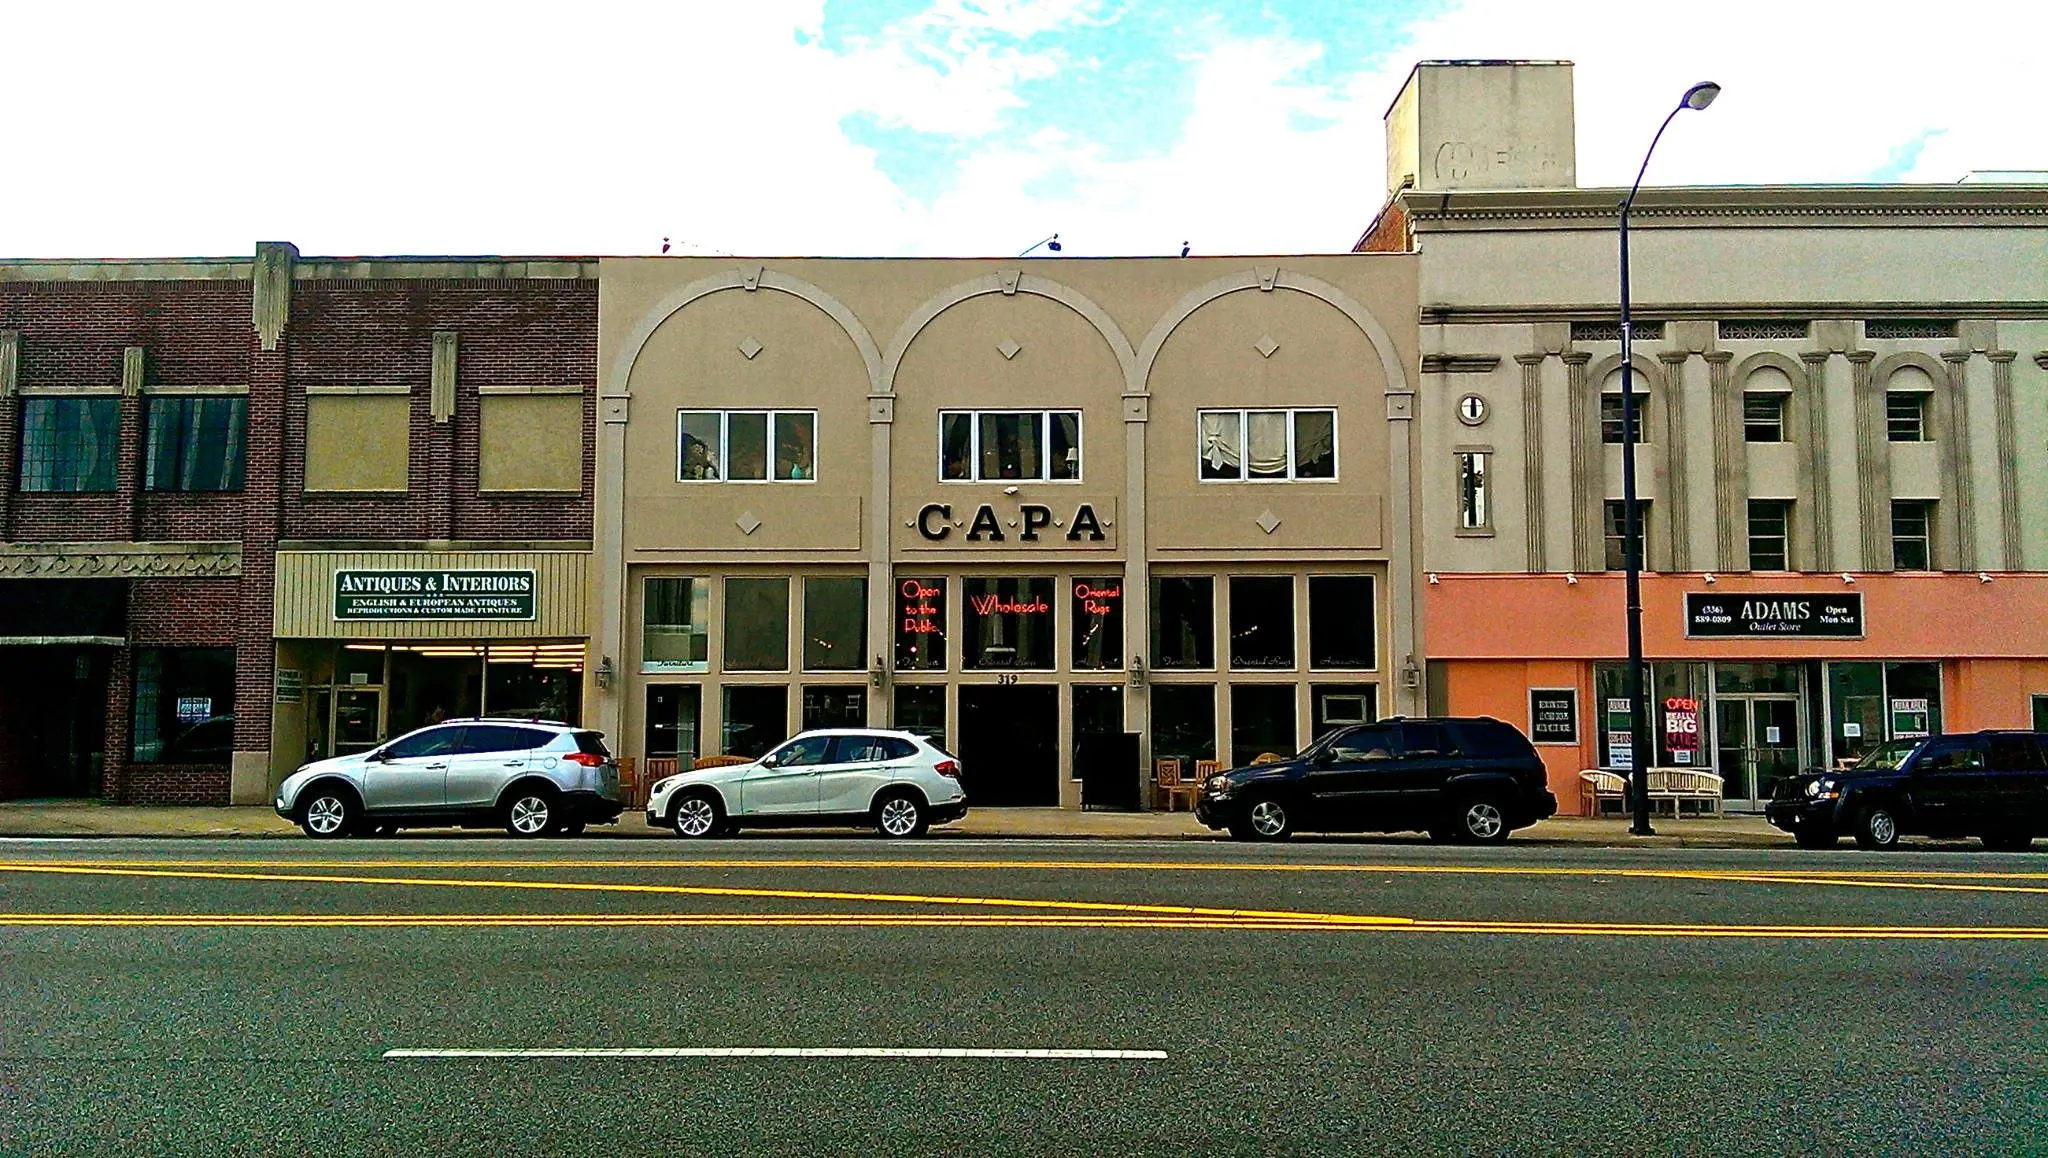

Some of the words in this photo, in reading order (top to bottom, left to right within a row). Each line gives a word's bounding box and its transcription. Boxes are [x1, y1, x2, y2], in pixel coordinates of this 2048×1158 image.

[917, 503, 1106, 541] CAPA
[340, 574, 421, 593] ANTIQUES
[425, 577, 438, 591] &
[442, 573, 530, 592] INTERIORS
[902, 580, 941, 598] Open
[1075, 584, 1121, 599] Oriental
[352, 599, 397, 607] ENGLISH
[399, 599, 407, 607] &
[409, 599, 465, 607] EUROPEAN
[466, 599, 518, 608] ANTIQUES
[905, 605, 918, 615] to
[919, 602, 937, 615] the
[970, 594, 1049, 615] Wholesale
[1084, 600, 1111, 615] Rugs
[1702, 606, 1723, 614] (336)
[1741, 600, 1811, 620] ADAMS
[1825, 606, 1848, 614] Open
[904, 618, 937, 633] Public
[1820, 615, 1838, 623] Mon
[1840, 615, 1854, 623] Sat
[1749, 622, 1777, 631] Outlet
[1778, 622, 1802, 631] Store
[998, 674, 1018, 685] 319
[1666, 698, 1698, 710] OPEN
[1665, 711, 1696, 720] REALLY
[1666, 719, 1697, 732] BIG
